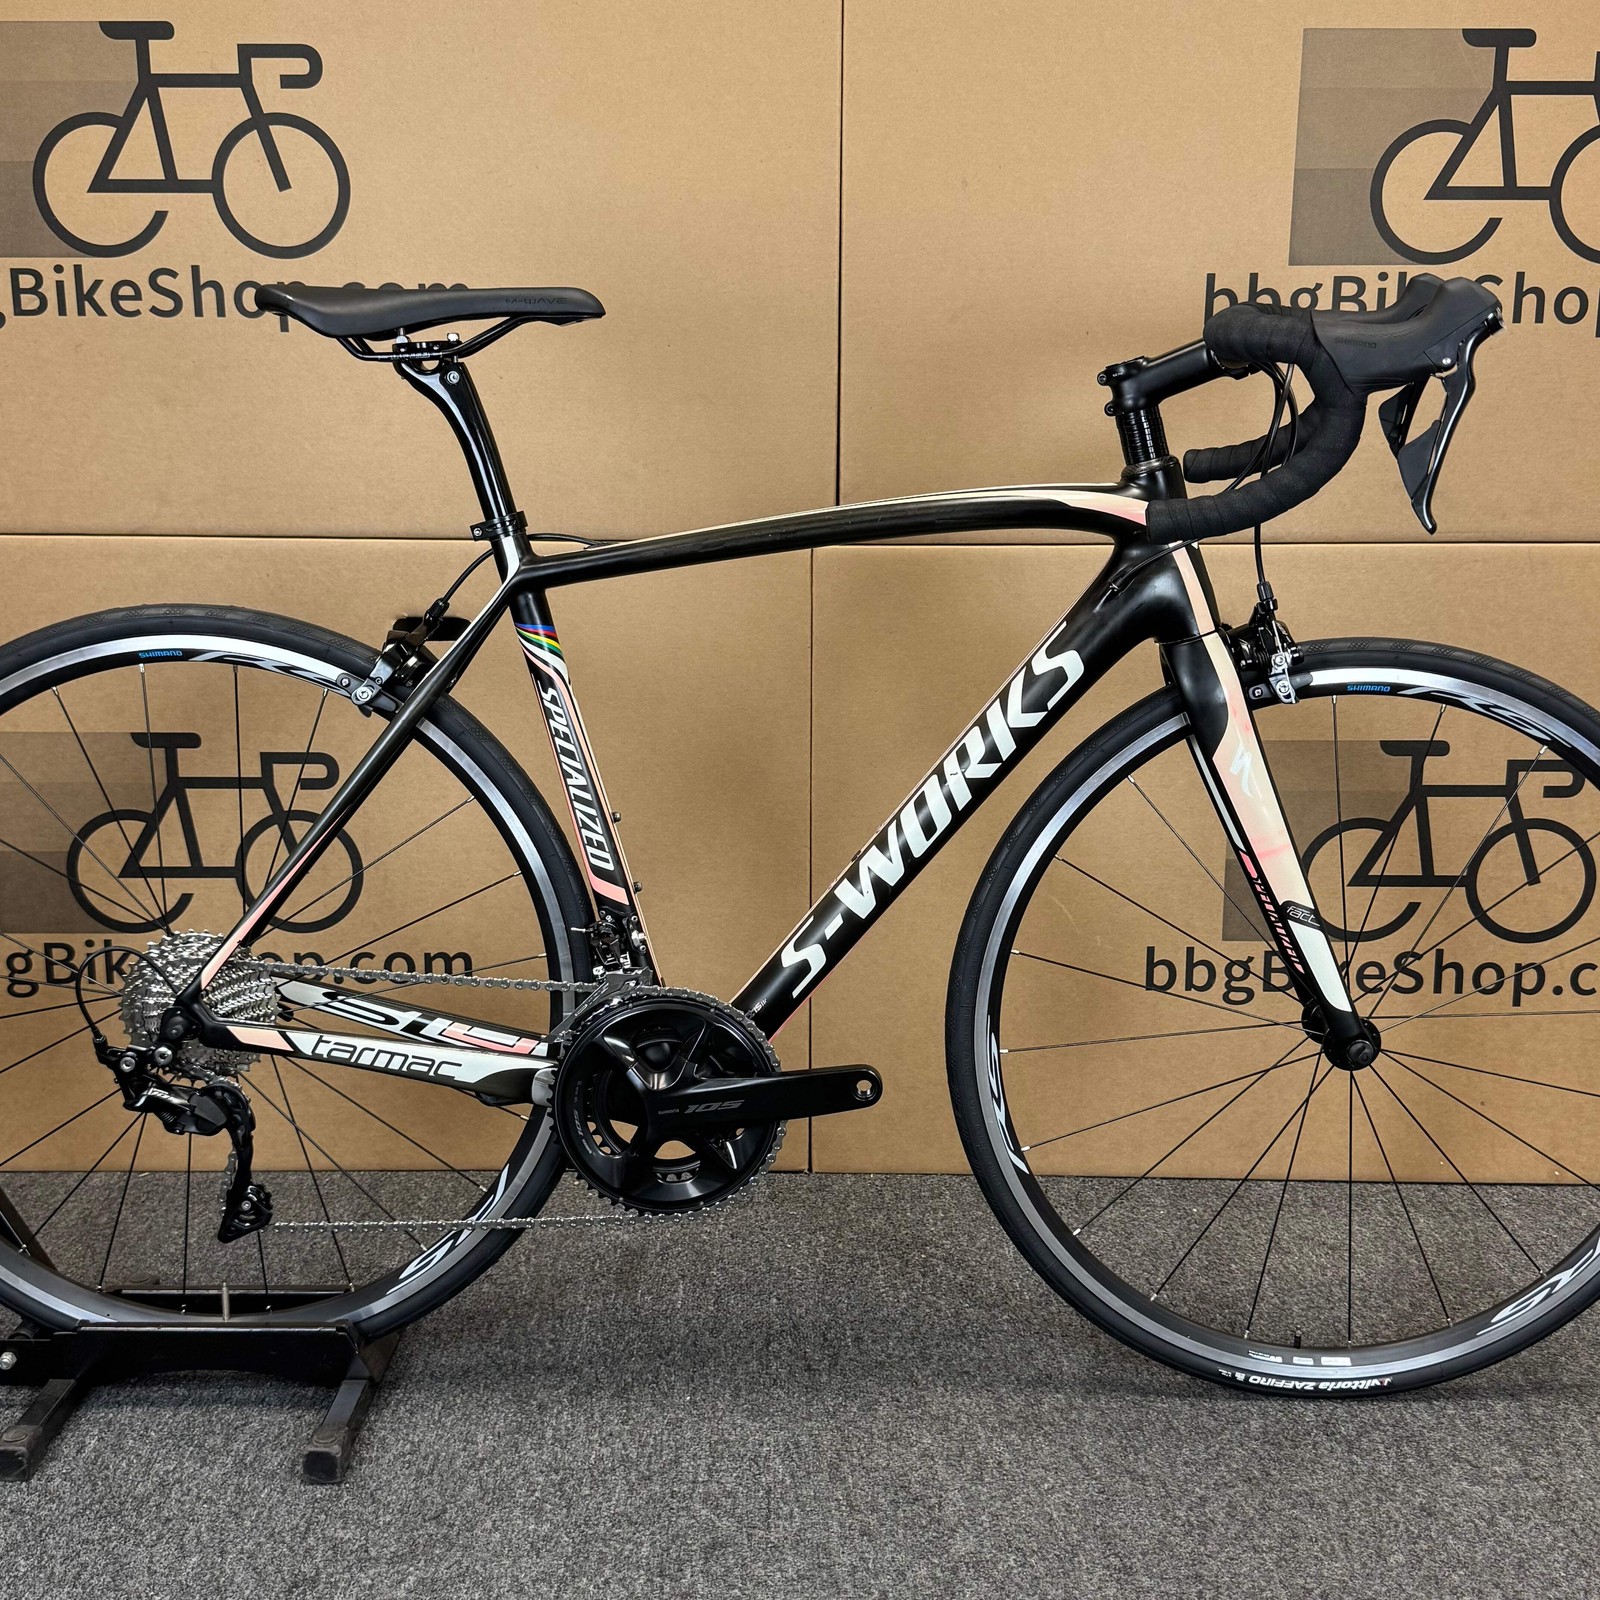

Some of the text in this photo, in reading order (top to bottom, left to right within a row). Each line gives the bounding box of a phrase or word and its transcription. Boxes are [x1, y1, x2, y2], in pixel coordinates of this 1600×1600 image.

[138, 649, 183, 659] SHIMANO
[1346, 684, 1391, 693] SHIMANO
[537, 680, 615, 871] SPECIALIZED
[780, 620, 1085, 999] S-WORKS
[1145, 945, 1599, 1008] bbgBeShop.c
[311, 1035, 463, 1077] tarmac
[684, 1100, 745, 1115] 105
[1249, 1375, 1381, 1392] vittoria ZAFFIRO
